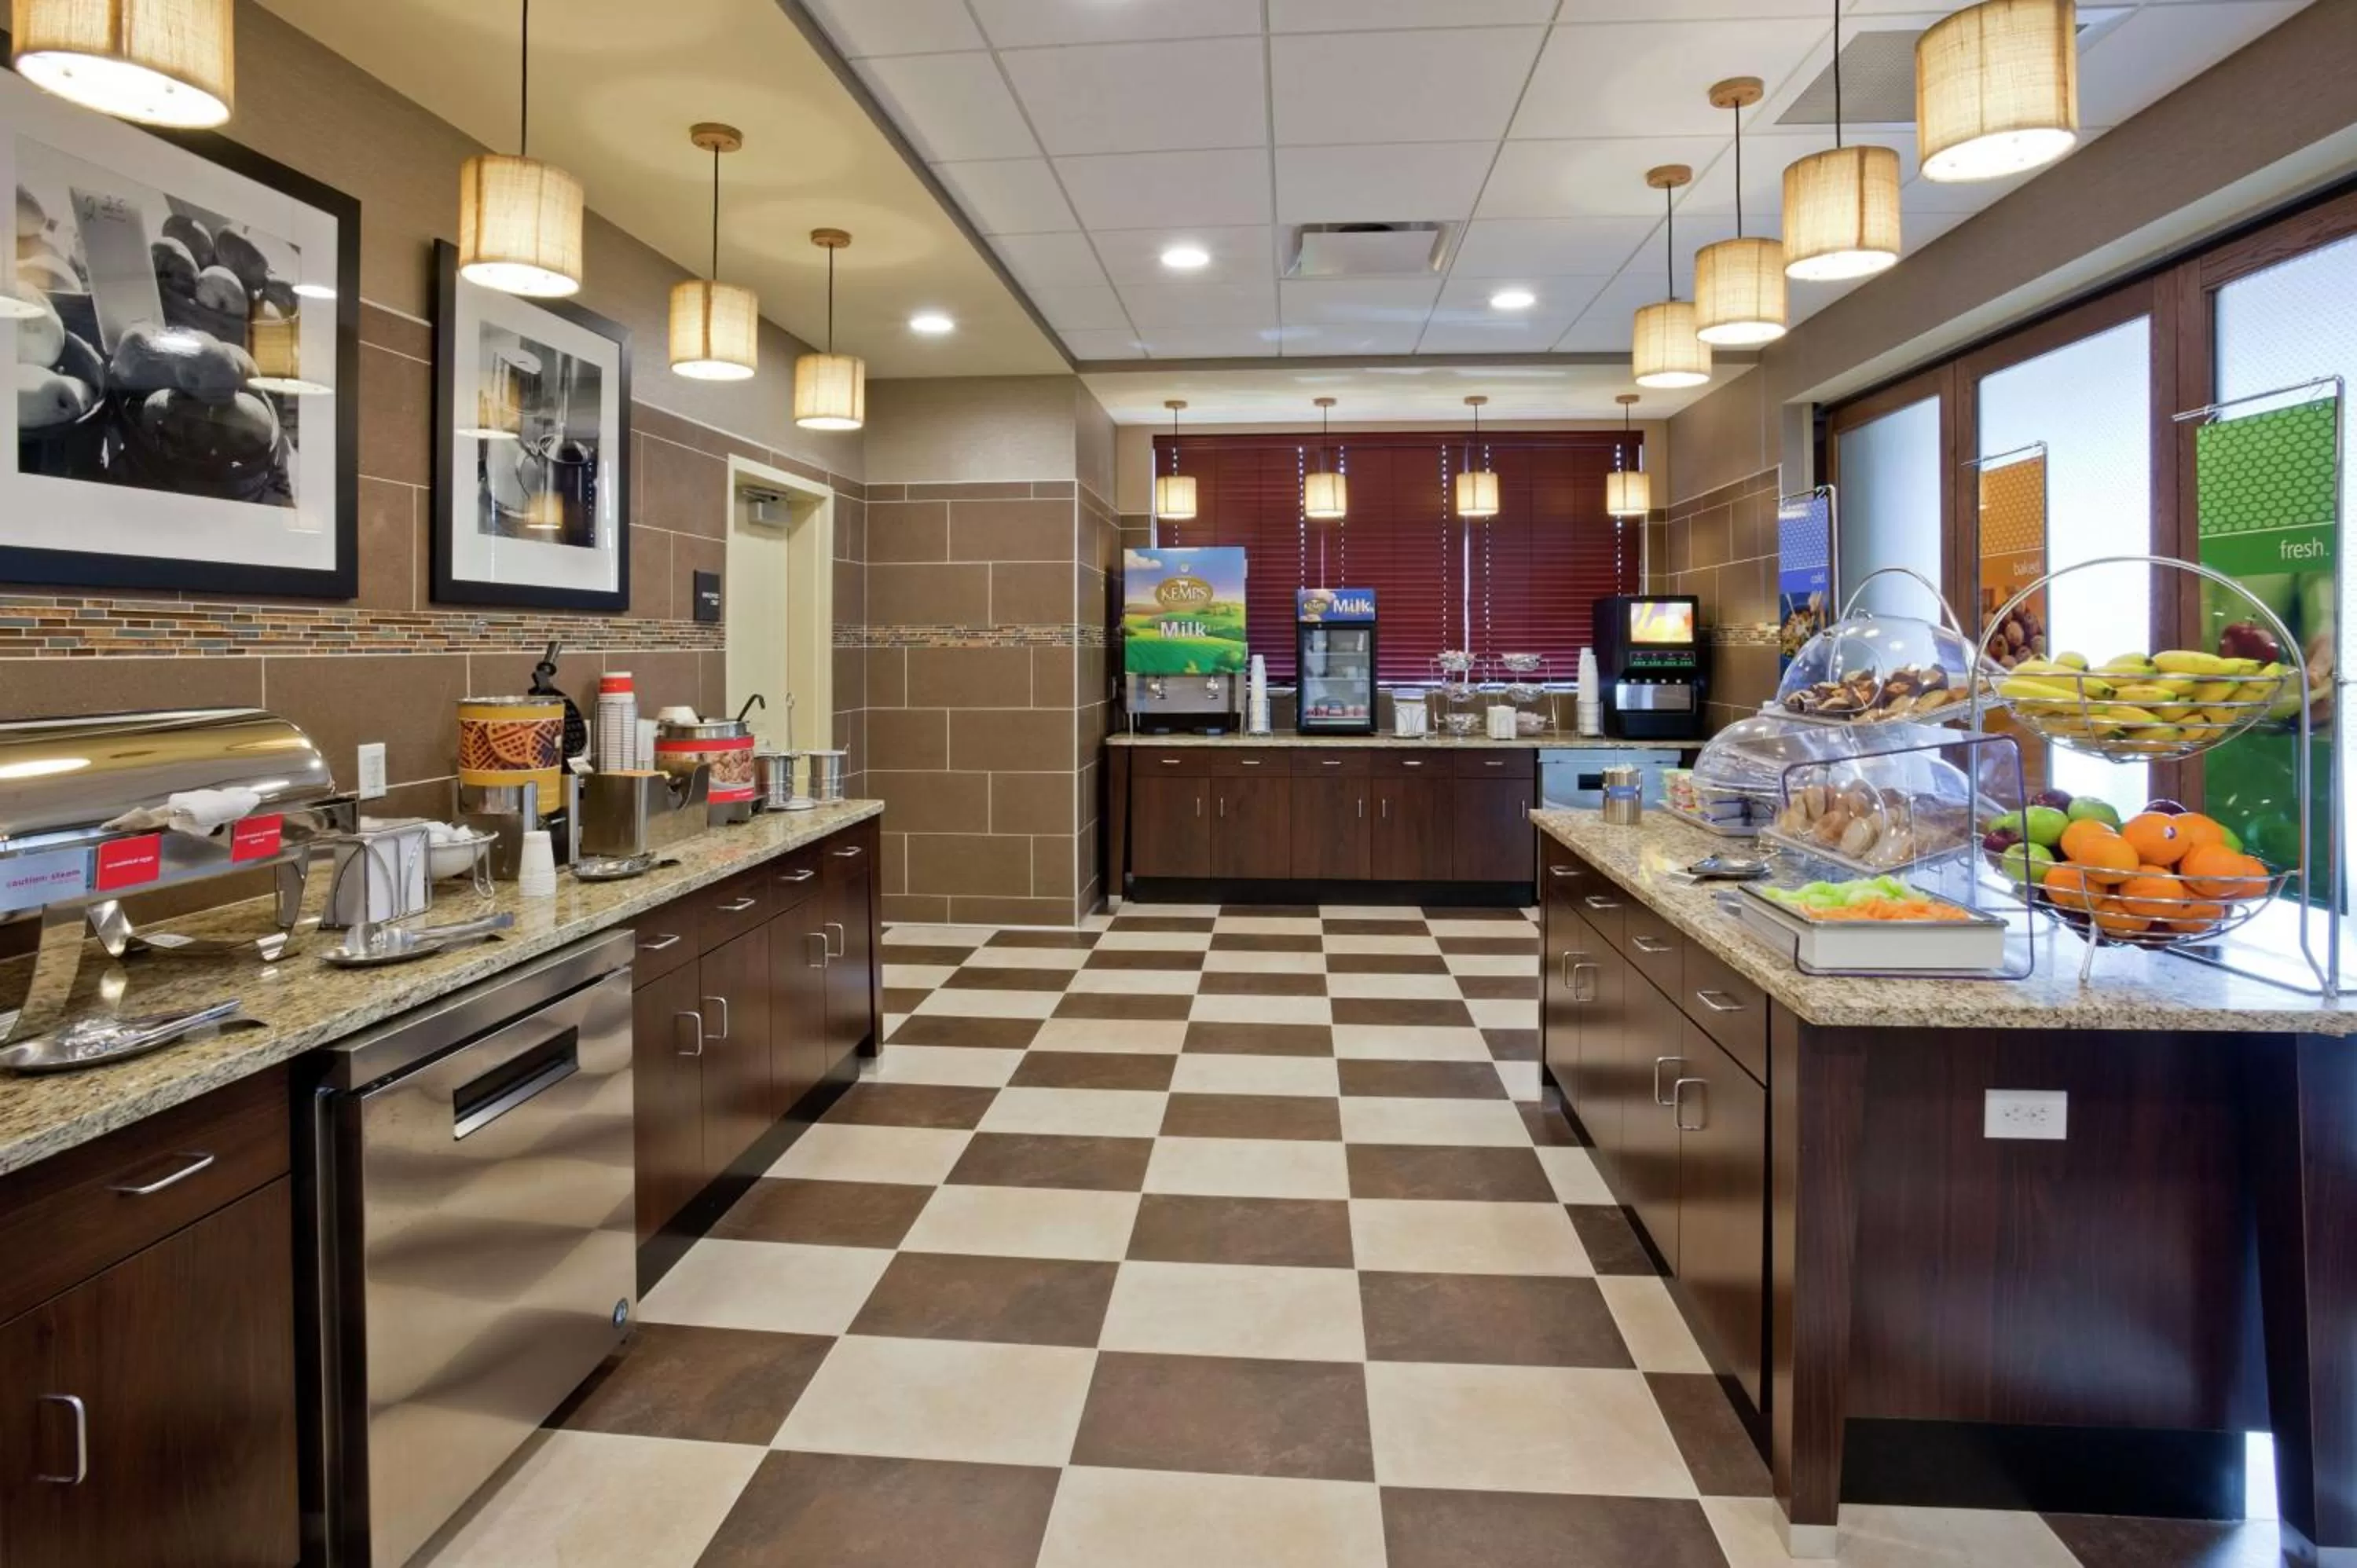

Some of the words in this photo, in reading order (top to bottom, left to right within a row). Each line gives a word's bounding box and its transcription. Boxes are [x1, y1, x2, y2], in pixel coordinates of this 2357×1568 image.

[2280, 537, 2331, 560] fresh.
[1161, 586, 1208, 603] KEMPS
[1333, 598, 1371, 614] Milk
[1160, 621, 1207, 639] Milk
